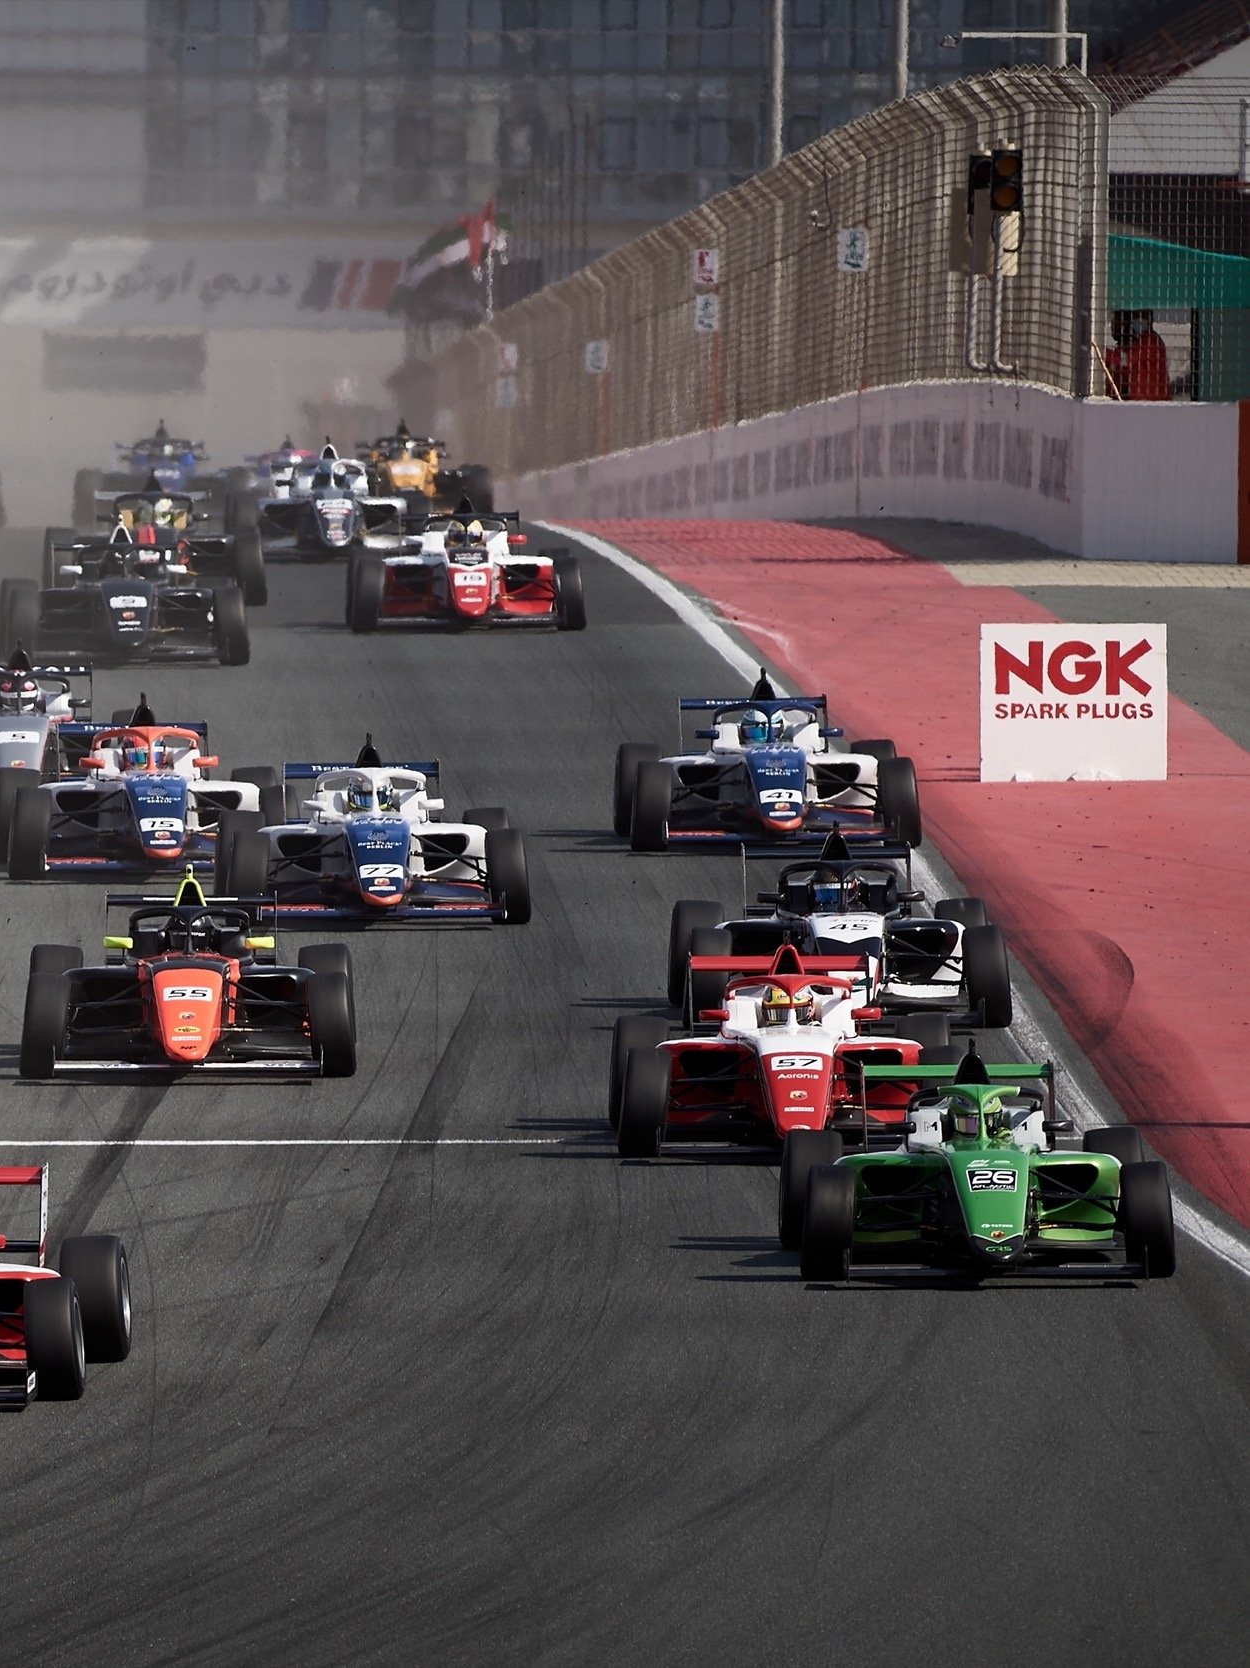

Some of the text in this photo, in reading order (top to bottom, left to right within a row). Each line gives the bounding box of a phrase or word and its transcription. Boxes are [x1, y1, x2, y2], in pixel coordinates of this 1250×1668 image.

[994, 638, 1153, 697] NGK
[994, 703, 1153, 720] SPARK PLUGS
[765, 791, 793, 800] 41
[148, 820, 174, 828] 15
[363, 867, 399, 875] 77
[828, 923, 869, 931] 45
[168, 989, 208, 998] 55
[776, 1058, 818, 1068] 57
[972, 1171, 1014, 1184] 26
